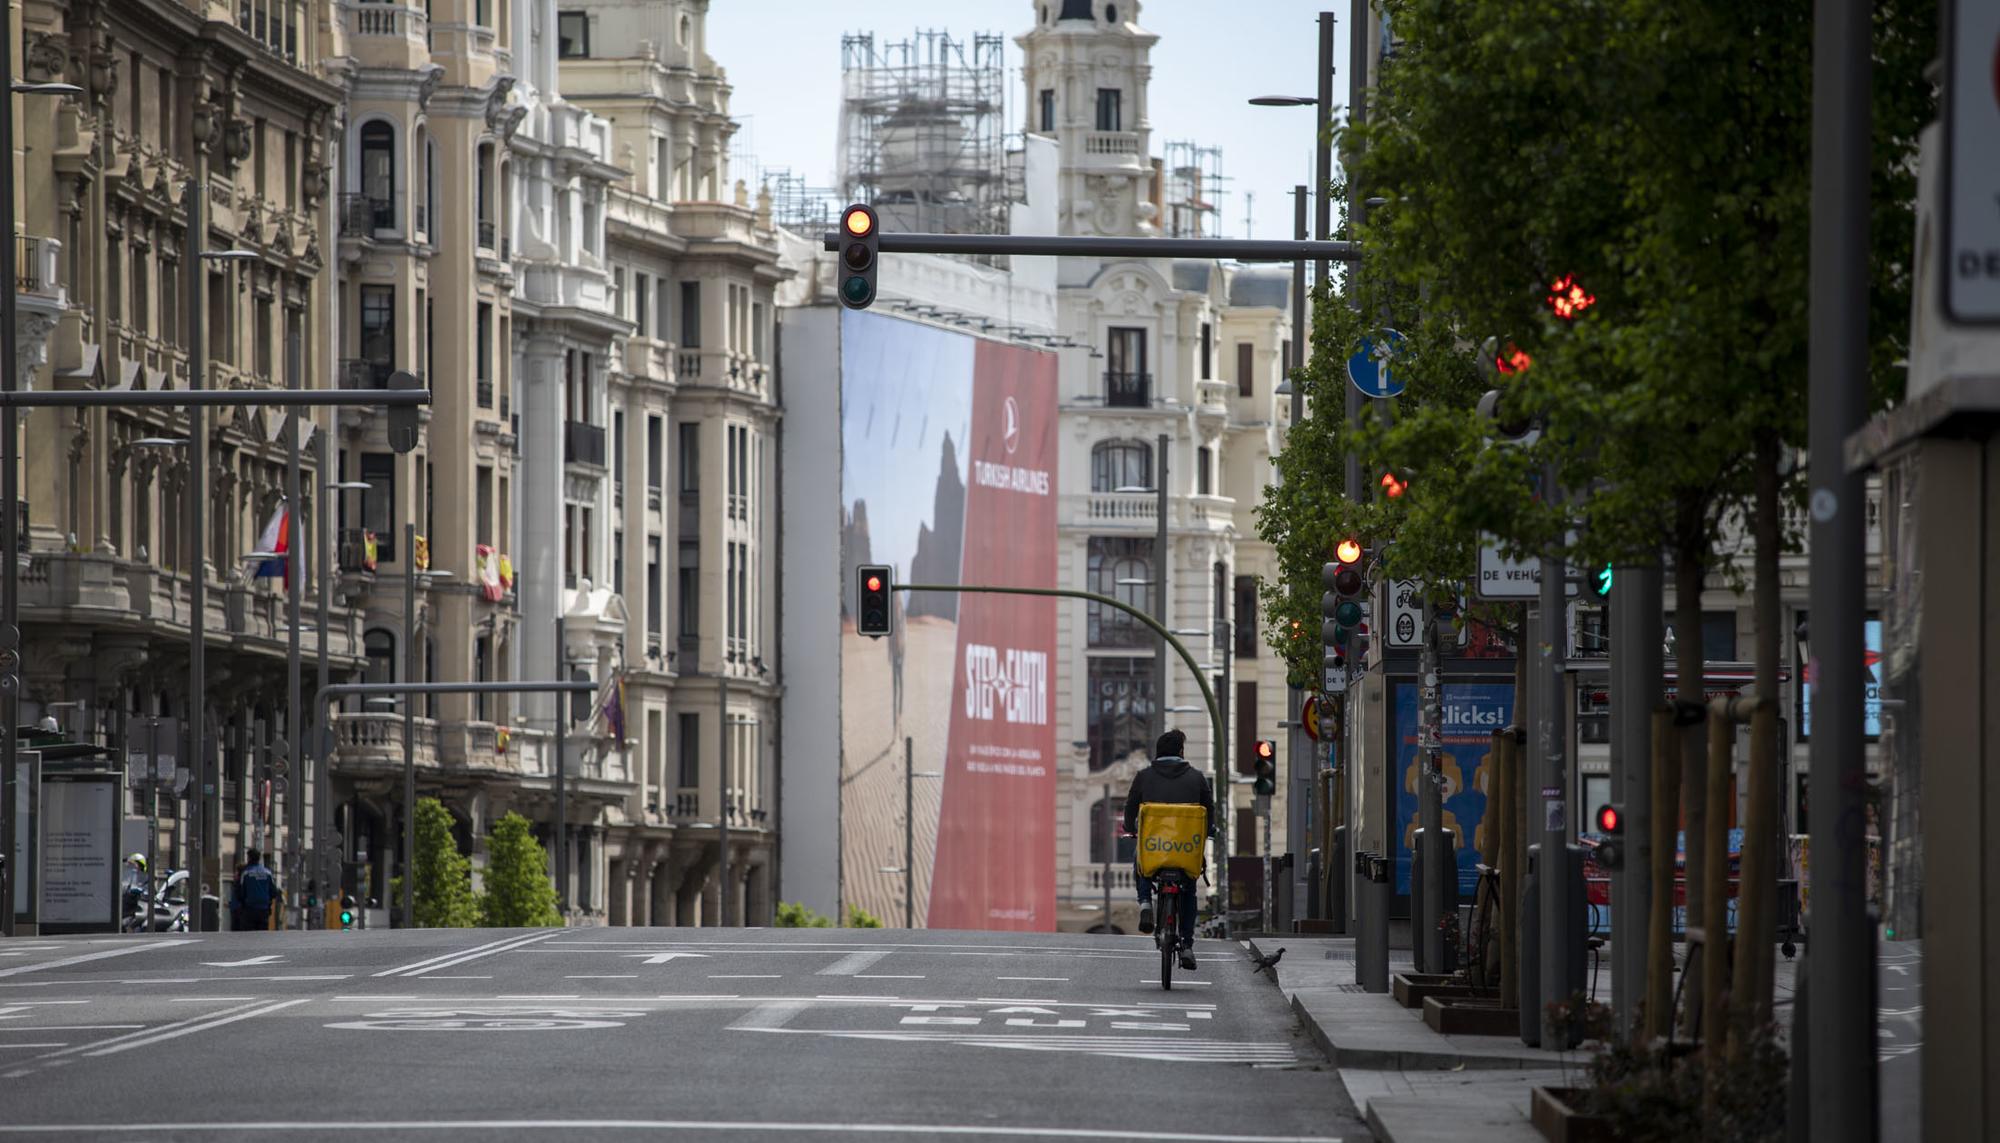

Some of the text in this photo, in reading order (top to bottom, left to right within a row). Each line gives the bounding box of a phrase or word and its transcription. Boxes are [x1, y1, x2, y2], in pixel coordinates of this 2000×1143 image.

[975, 460, 1050, 496] TURKISH AIRLINES
[1483, 570, 1499, 581] DE
[1006, 648, 1048, 726] EARTH
[1145, 837, 1194, 853] Glovo
[889, 1004, 1213, 1019] TAXI
[900, 1016, 1191, 1031] BUS
